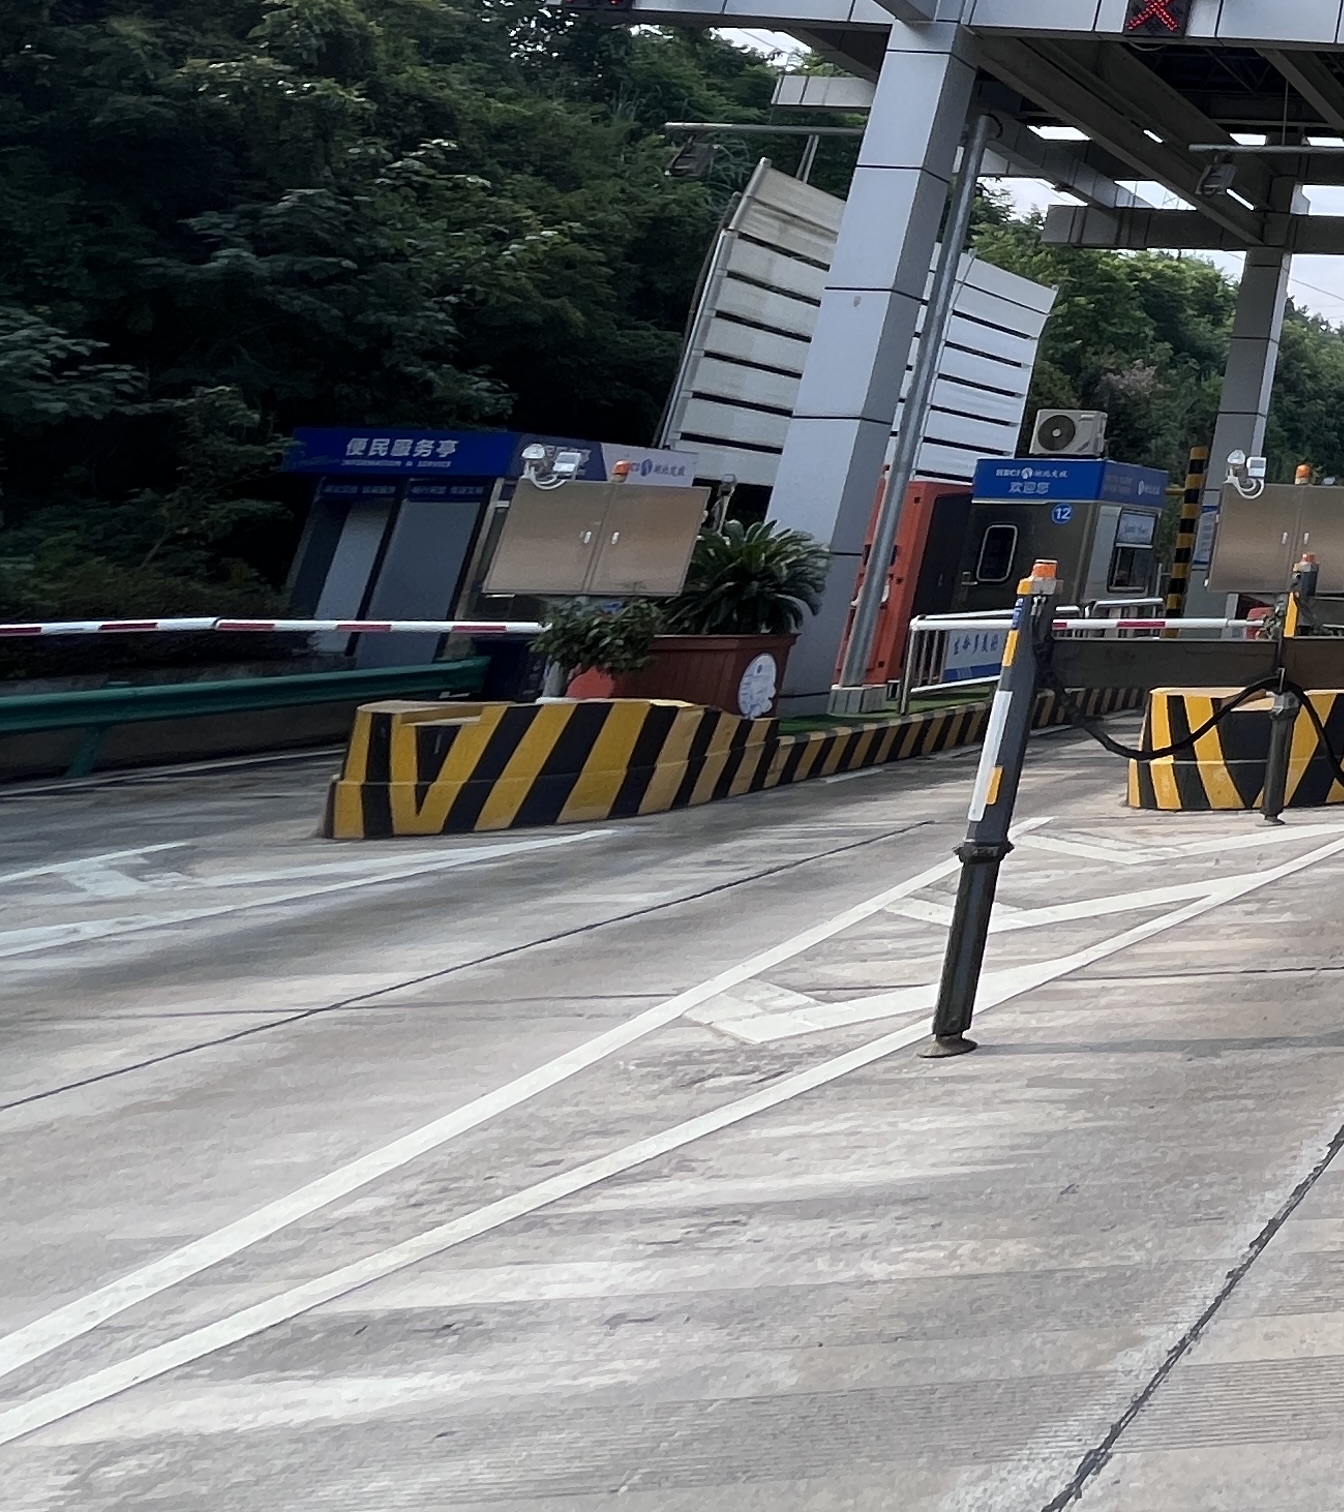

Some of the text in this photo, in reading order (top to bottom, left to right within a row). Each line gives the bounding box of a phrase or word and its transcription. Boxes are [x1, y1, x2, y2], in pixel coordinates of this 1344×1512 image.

[345, 437, 459, 459] 便民服务亭
[1008, 481, 1051, 494] 欢迎您
[1054, 507, 1071, 520] 12
